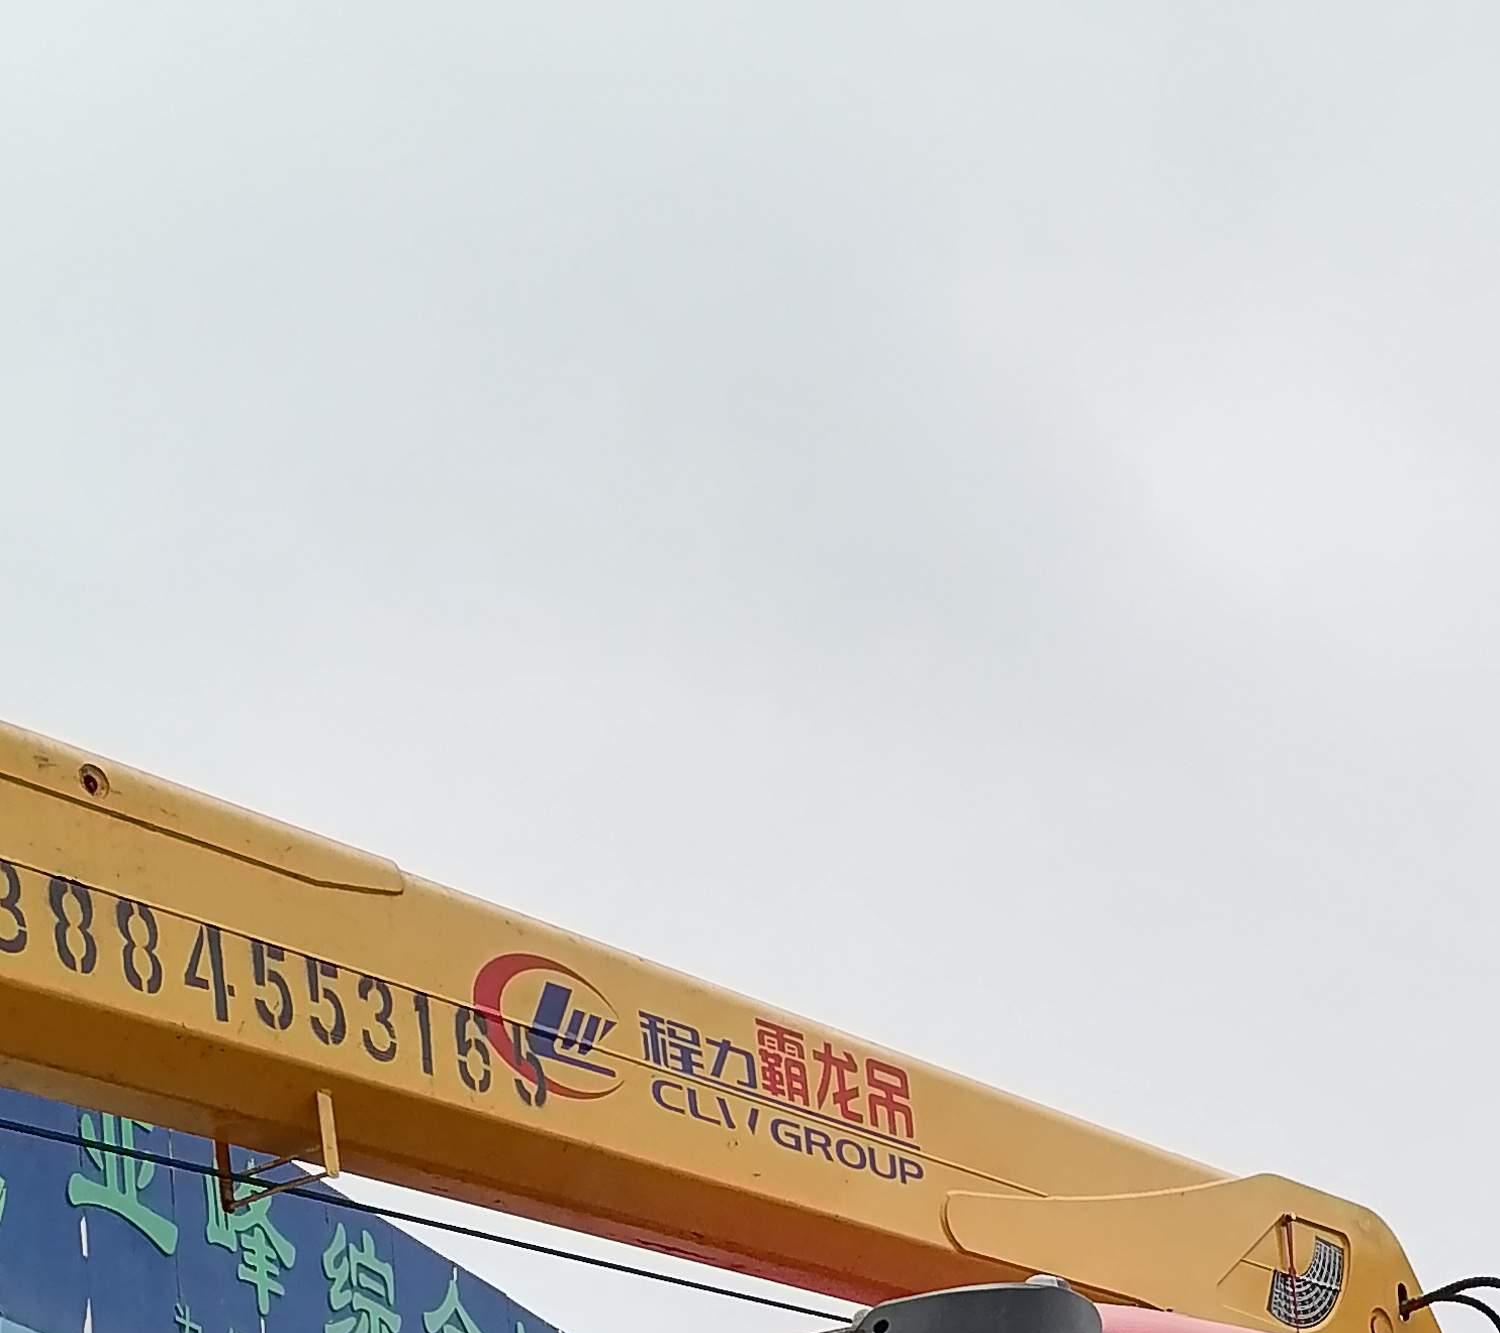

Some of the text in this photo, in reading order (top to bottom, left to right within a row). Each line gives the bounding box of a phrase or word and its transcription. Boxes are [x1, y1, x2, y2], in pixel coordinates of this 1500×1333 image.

[638, 1010, 915, 1138] 程力霸龙吊
[769, 1117, 925, 1185] GROUP
